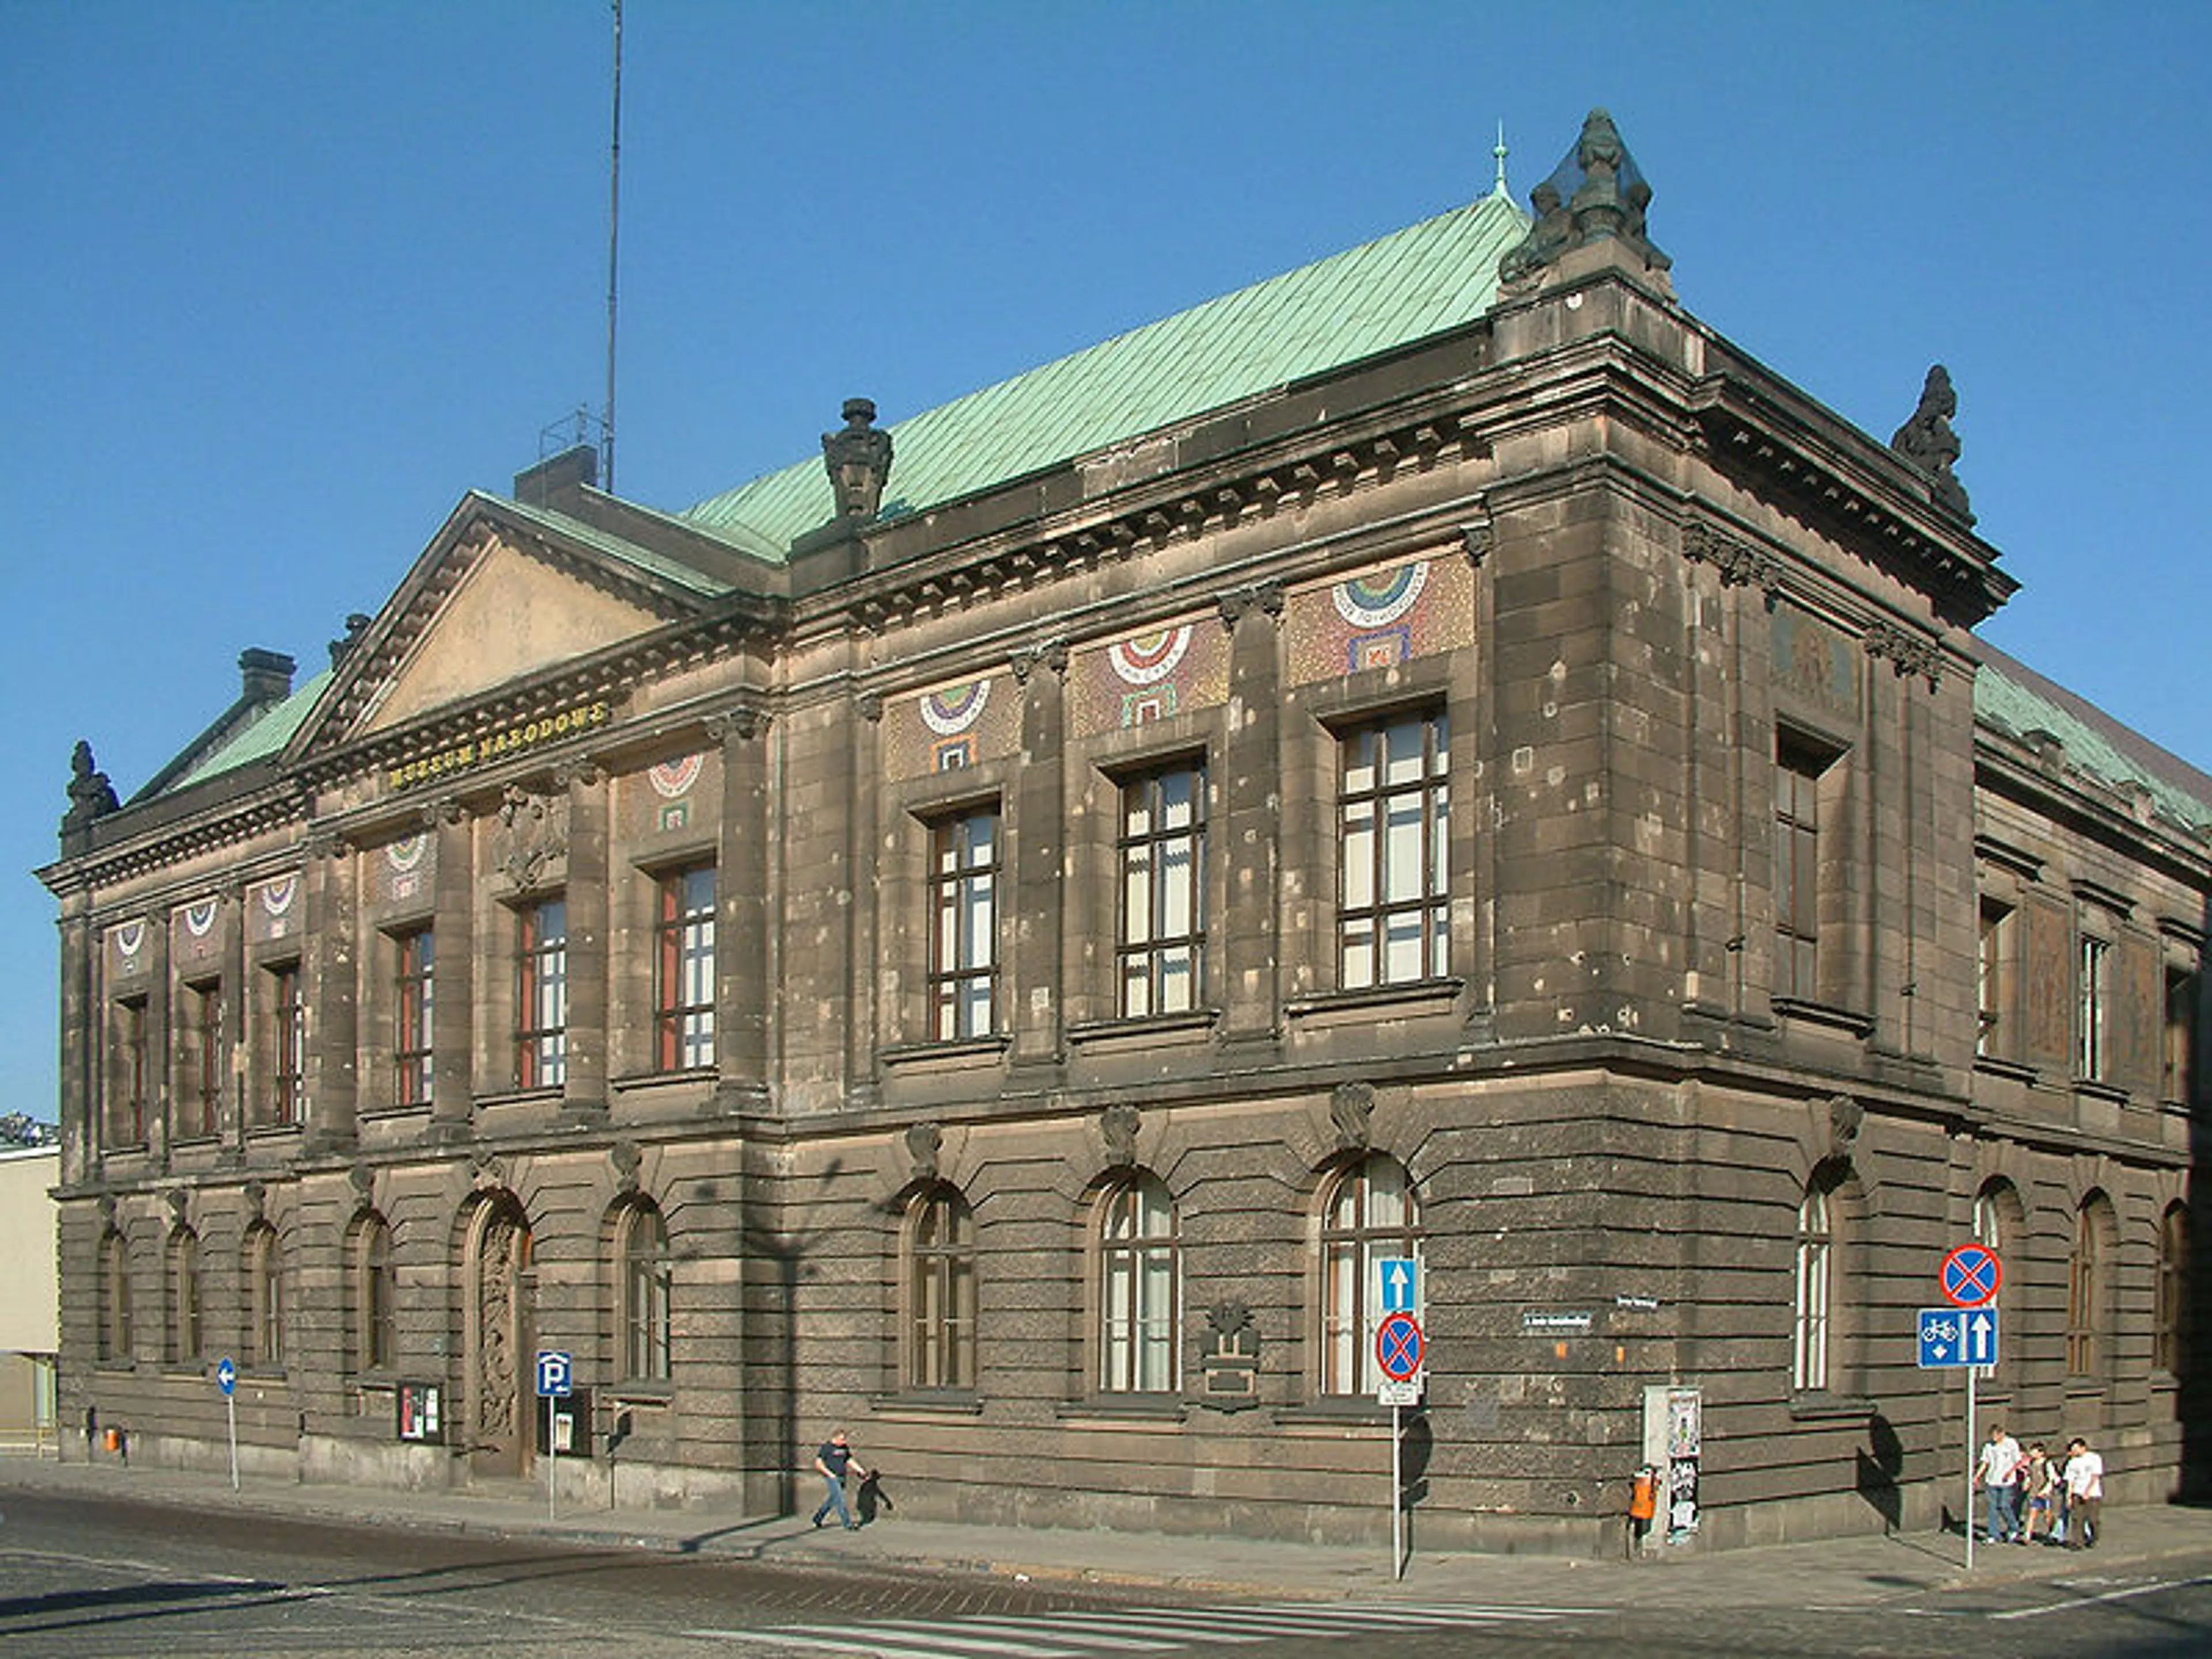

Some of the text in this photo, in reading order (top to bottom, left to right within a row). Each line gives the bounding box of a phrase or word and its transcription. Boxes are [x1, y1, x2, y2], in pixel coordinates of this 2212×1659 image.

[389, 701, 608, 787] MUZEUM NARODOWE
[544, 1363, 565, 1389] P
